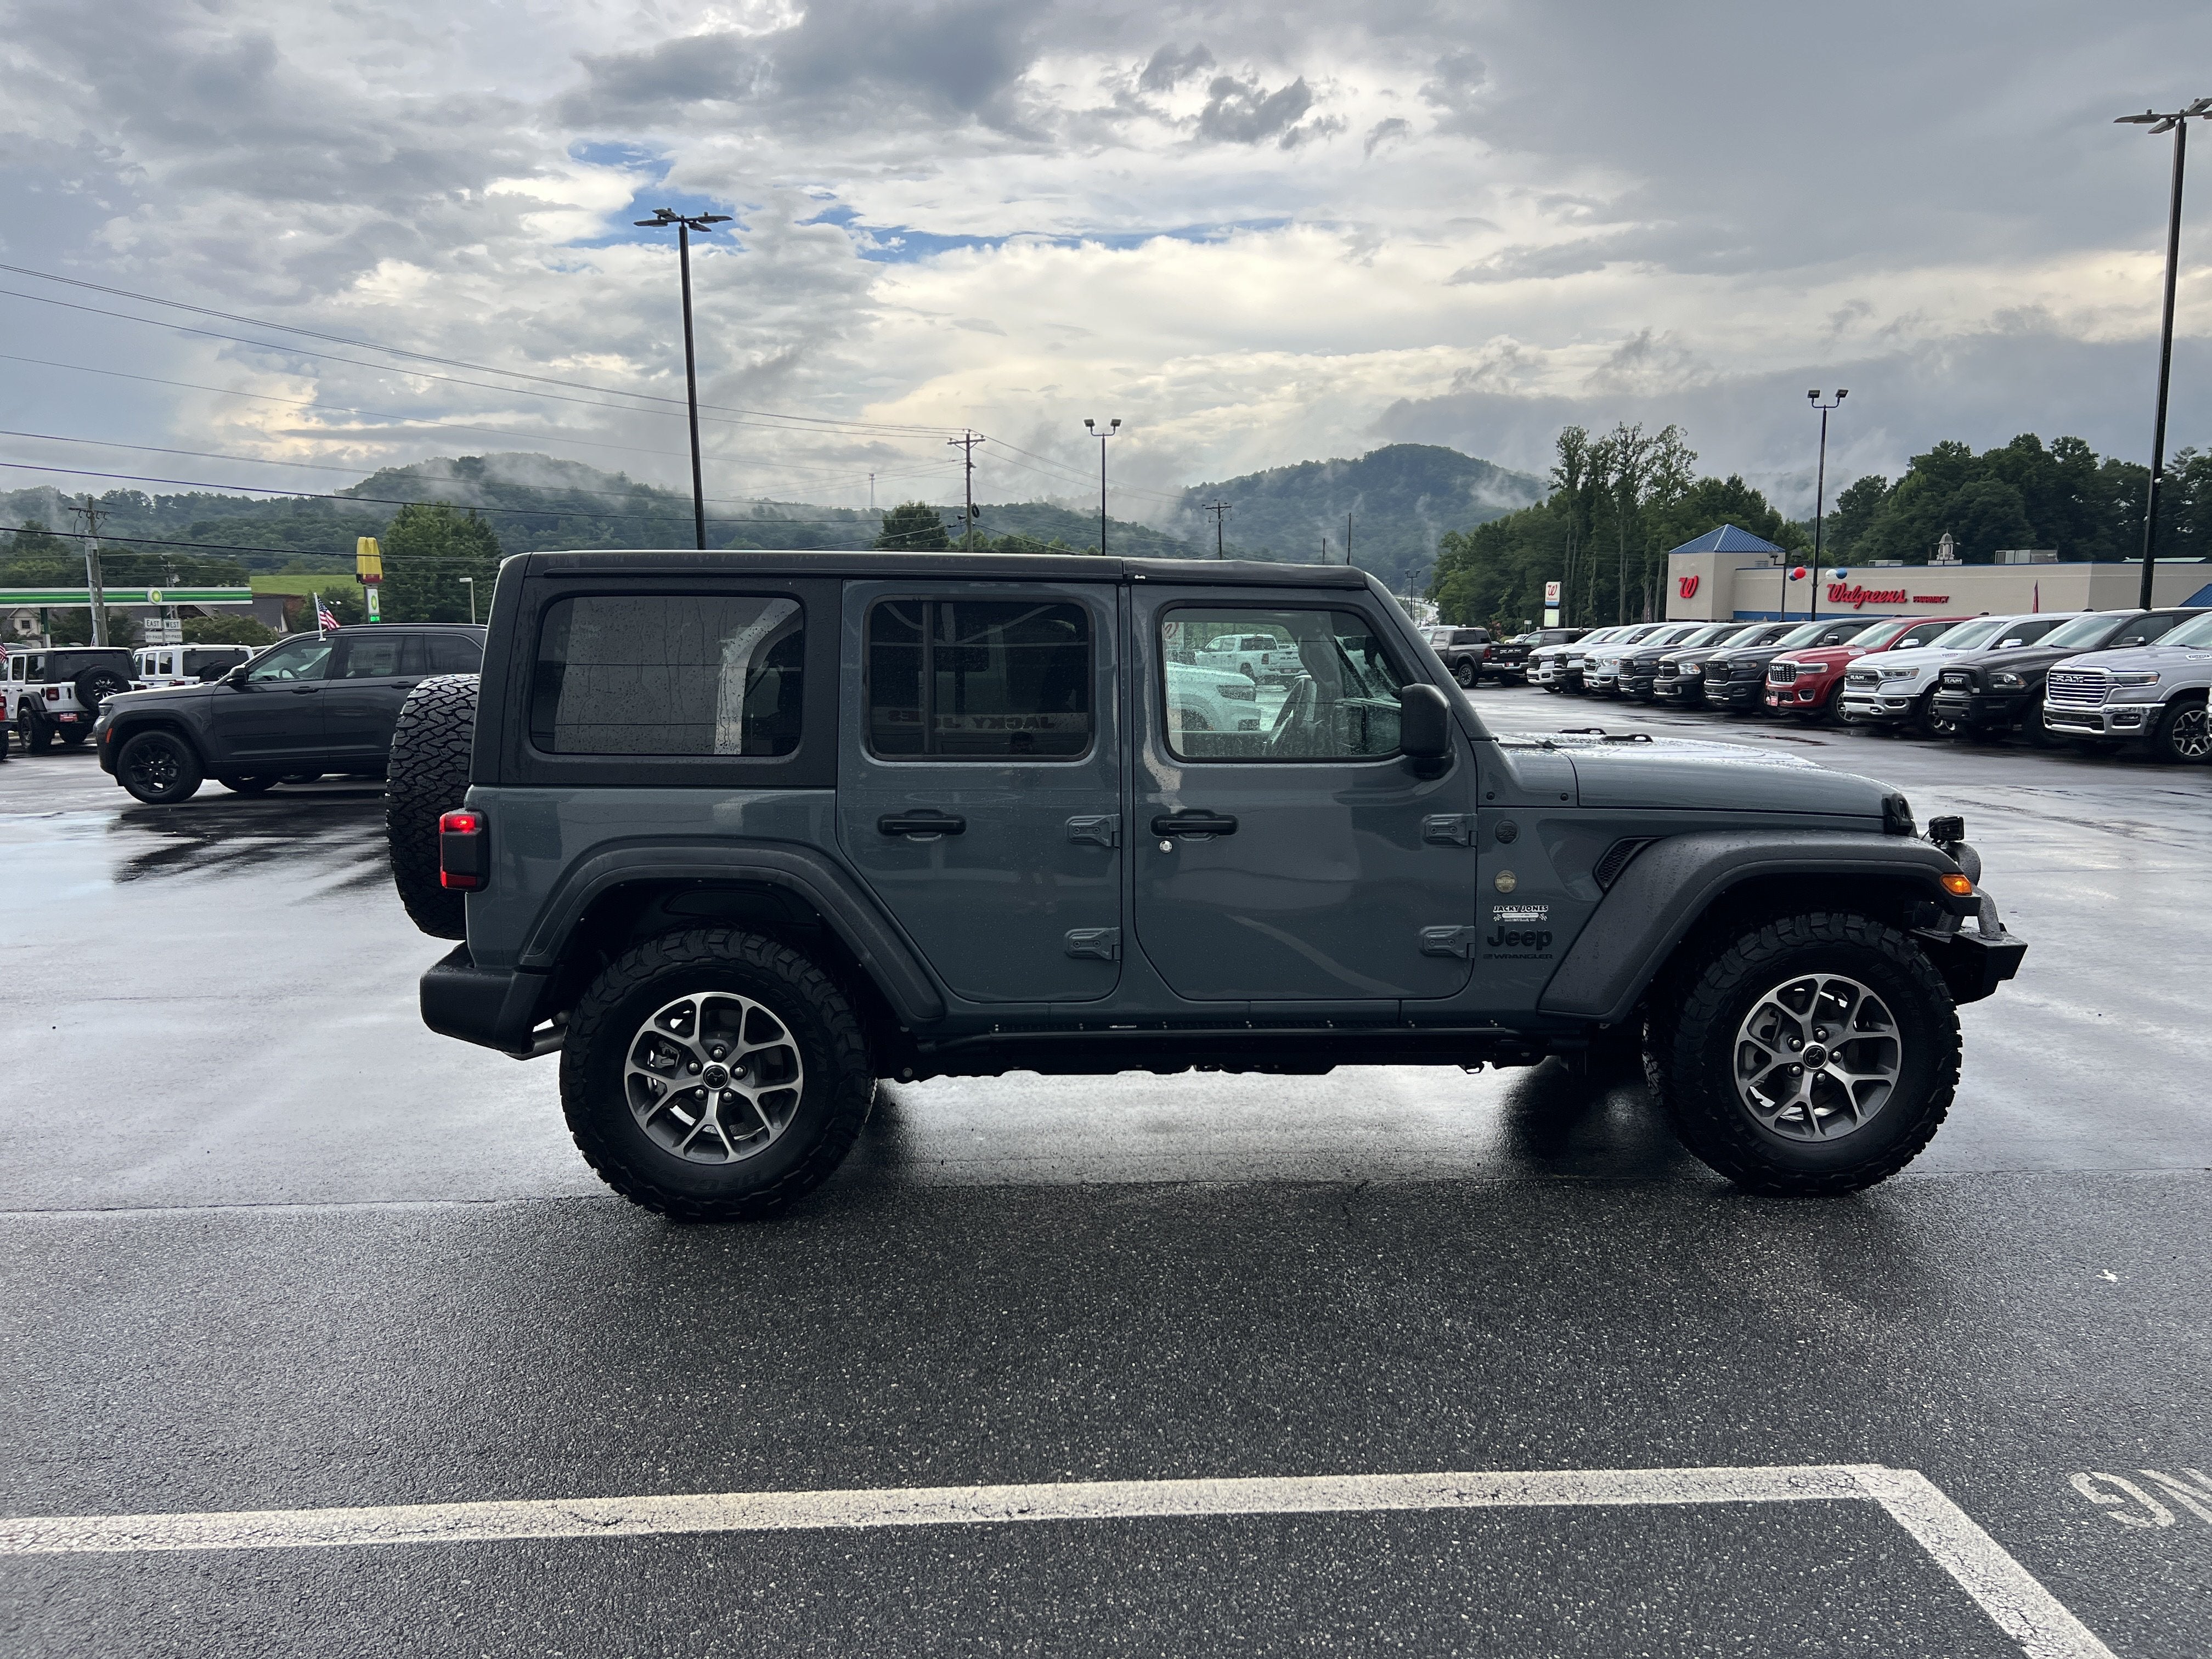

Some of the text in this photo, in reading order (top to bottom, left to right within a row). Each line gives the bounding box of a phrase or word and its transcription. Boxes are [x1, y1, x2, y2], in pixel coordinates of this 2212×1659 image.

[1679, 575, 1699, 599] W
[1826, 583, 1907, 610] Walgreens
[1487, 925, 1553, 950] Jeep
